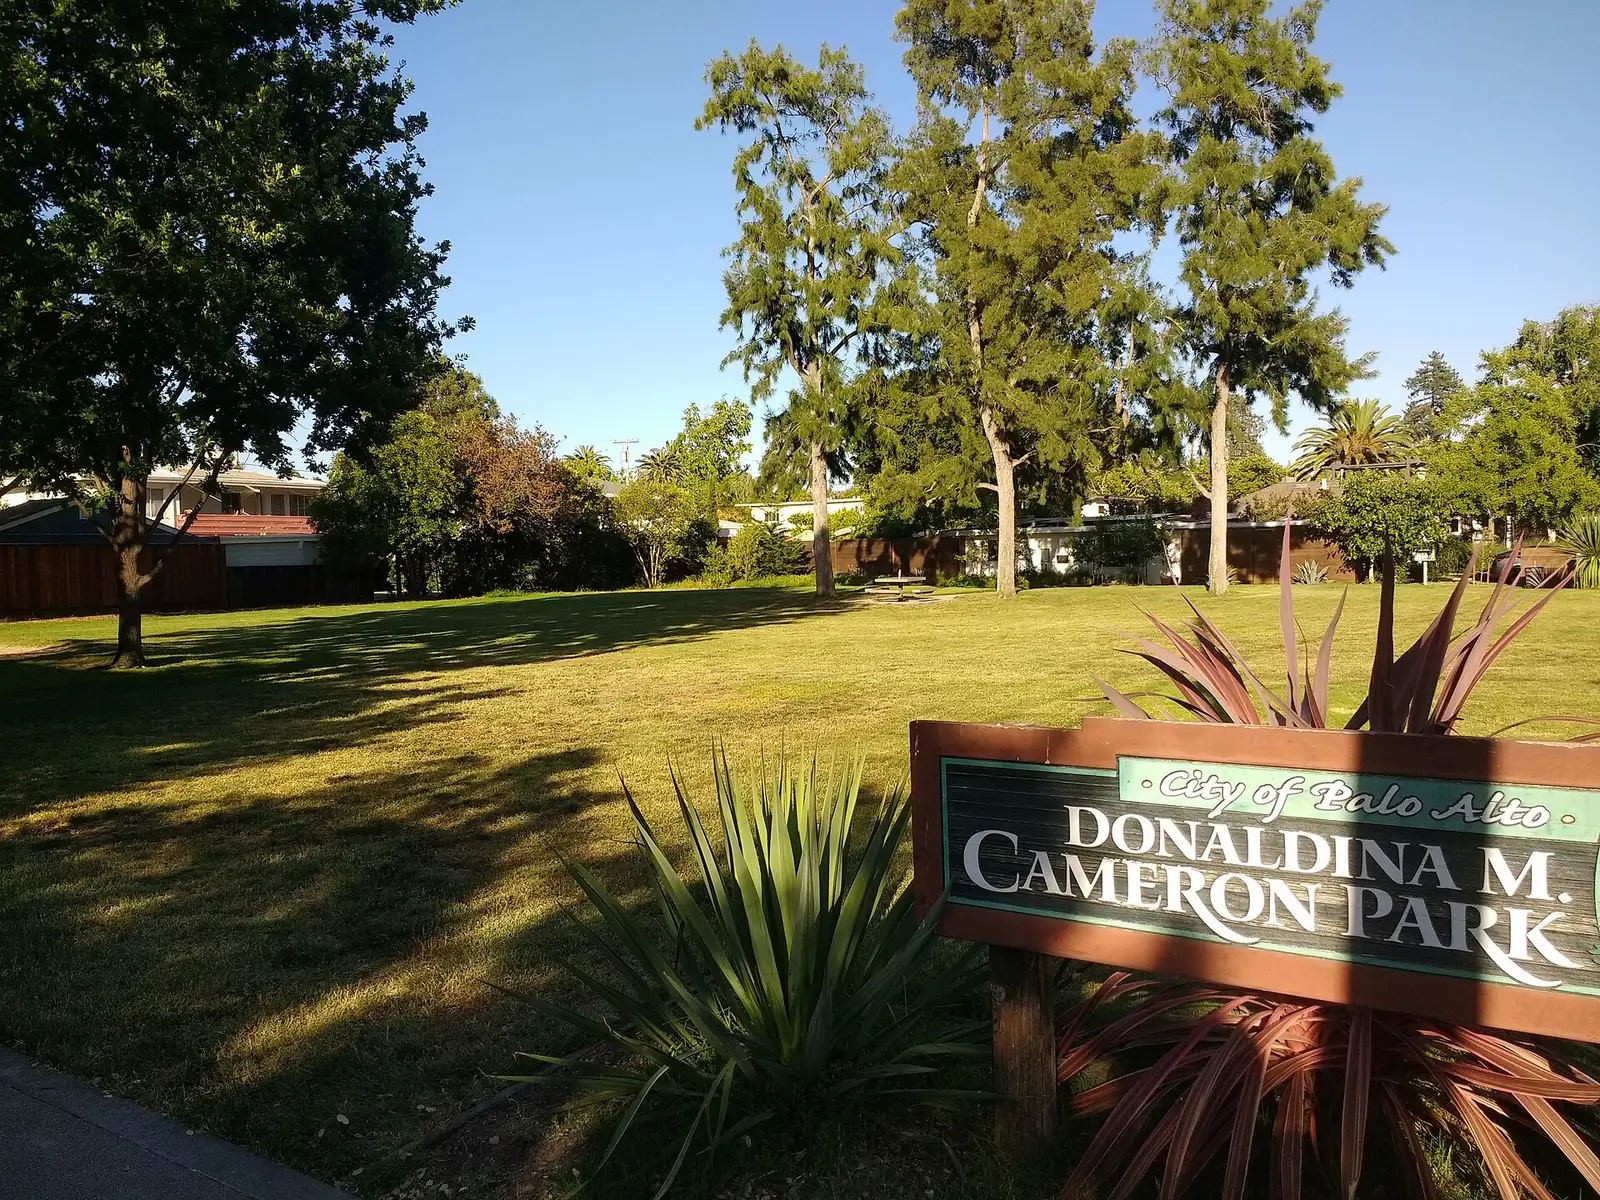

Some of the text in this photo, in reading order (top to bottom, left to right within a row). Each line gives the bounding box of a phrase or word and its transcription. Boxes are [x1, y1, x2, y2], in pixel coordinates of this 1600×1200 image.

[1159, 769, 1550, 829] City of Palo Alto
[1063, 804, 1572, 905] DONALDINA M.
[962, 828, 1583, 989] CAMERON PARK
